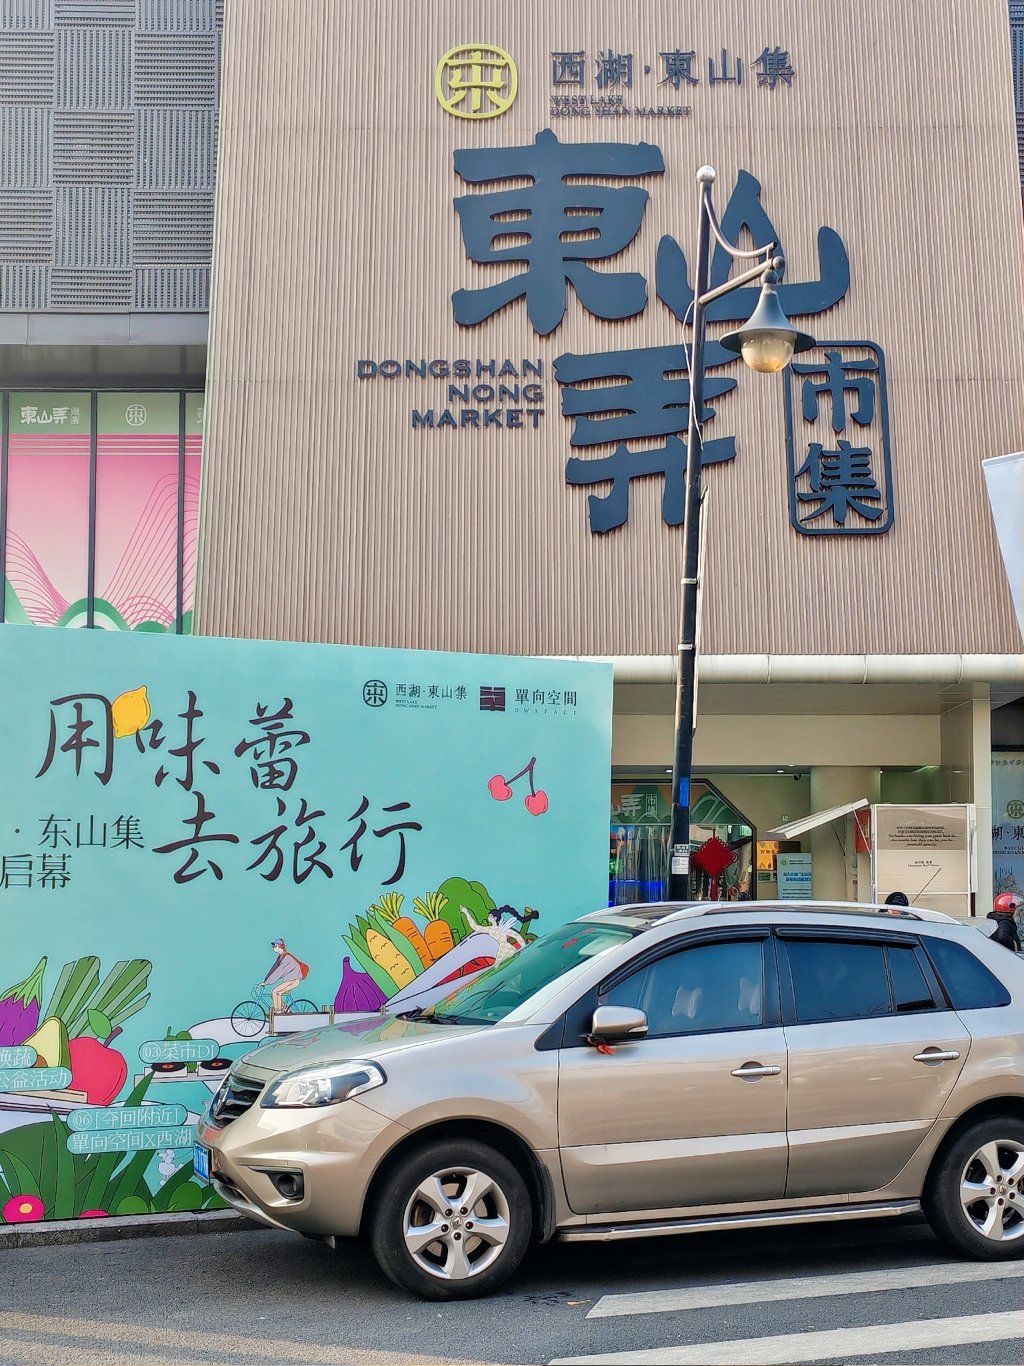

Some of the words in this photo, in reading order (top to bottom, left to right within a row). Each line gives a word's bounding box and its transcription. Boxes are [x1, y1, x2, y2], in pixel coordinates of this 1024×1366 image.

[550, 94, 586, 105] WEST
[591, 94, 623, 105] LAKE
[550, 106, 591, 116] DONG
[595, 105, 632, 116] SHAN
[635, 105, 692, 117] MARKET
[357, 358, 544, 379] DONGSHAN
[448, 383, 545, 403] NONG
[411, 409, 545, 430] MARKET
[152, 789, 423, 886] 去旅行
